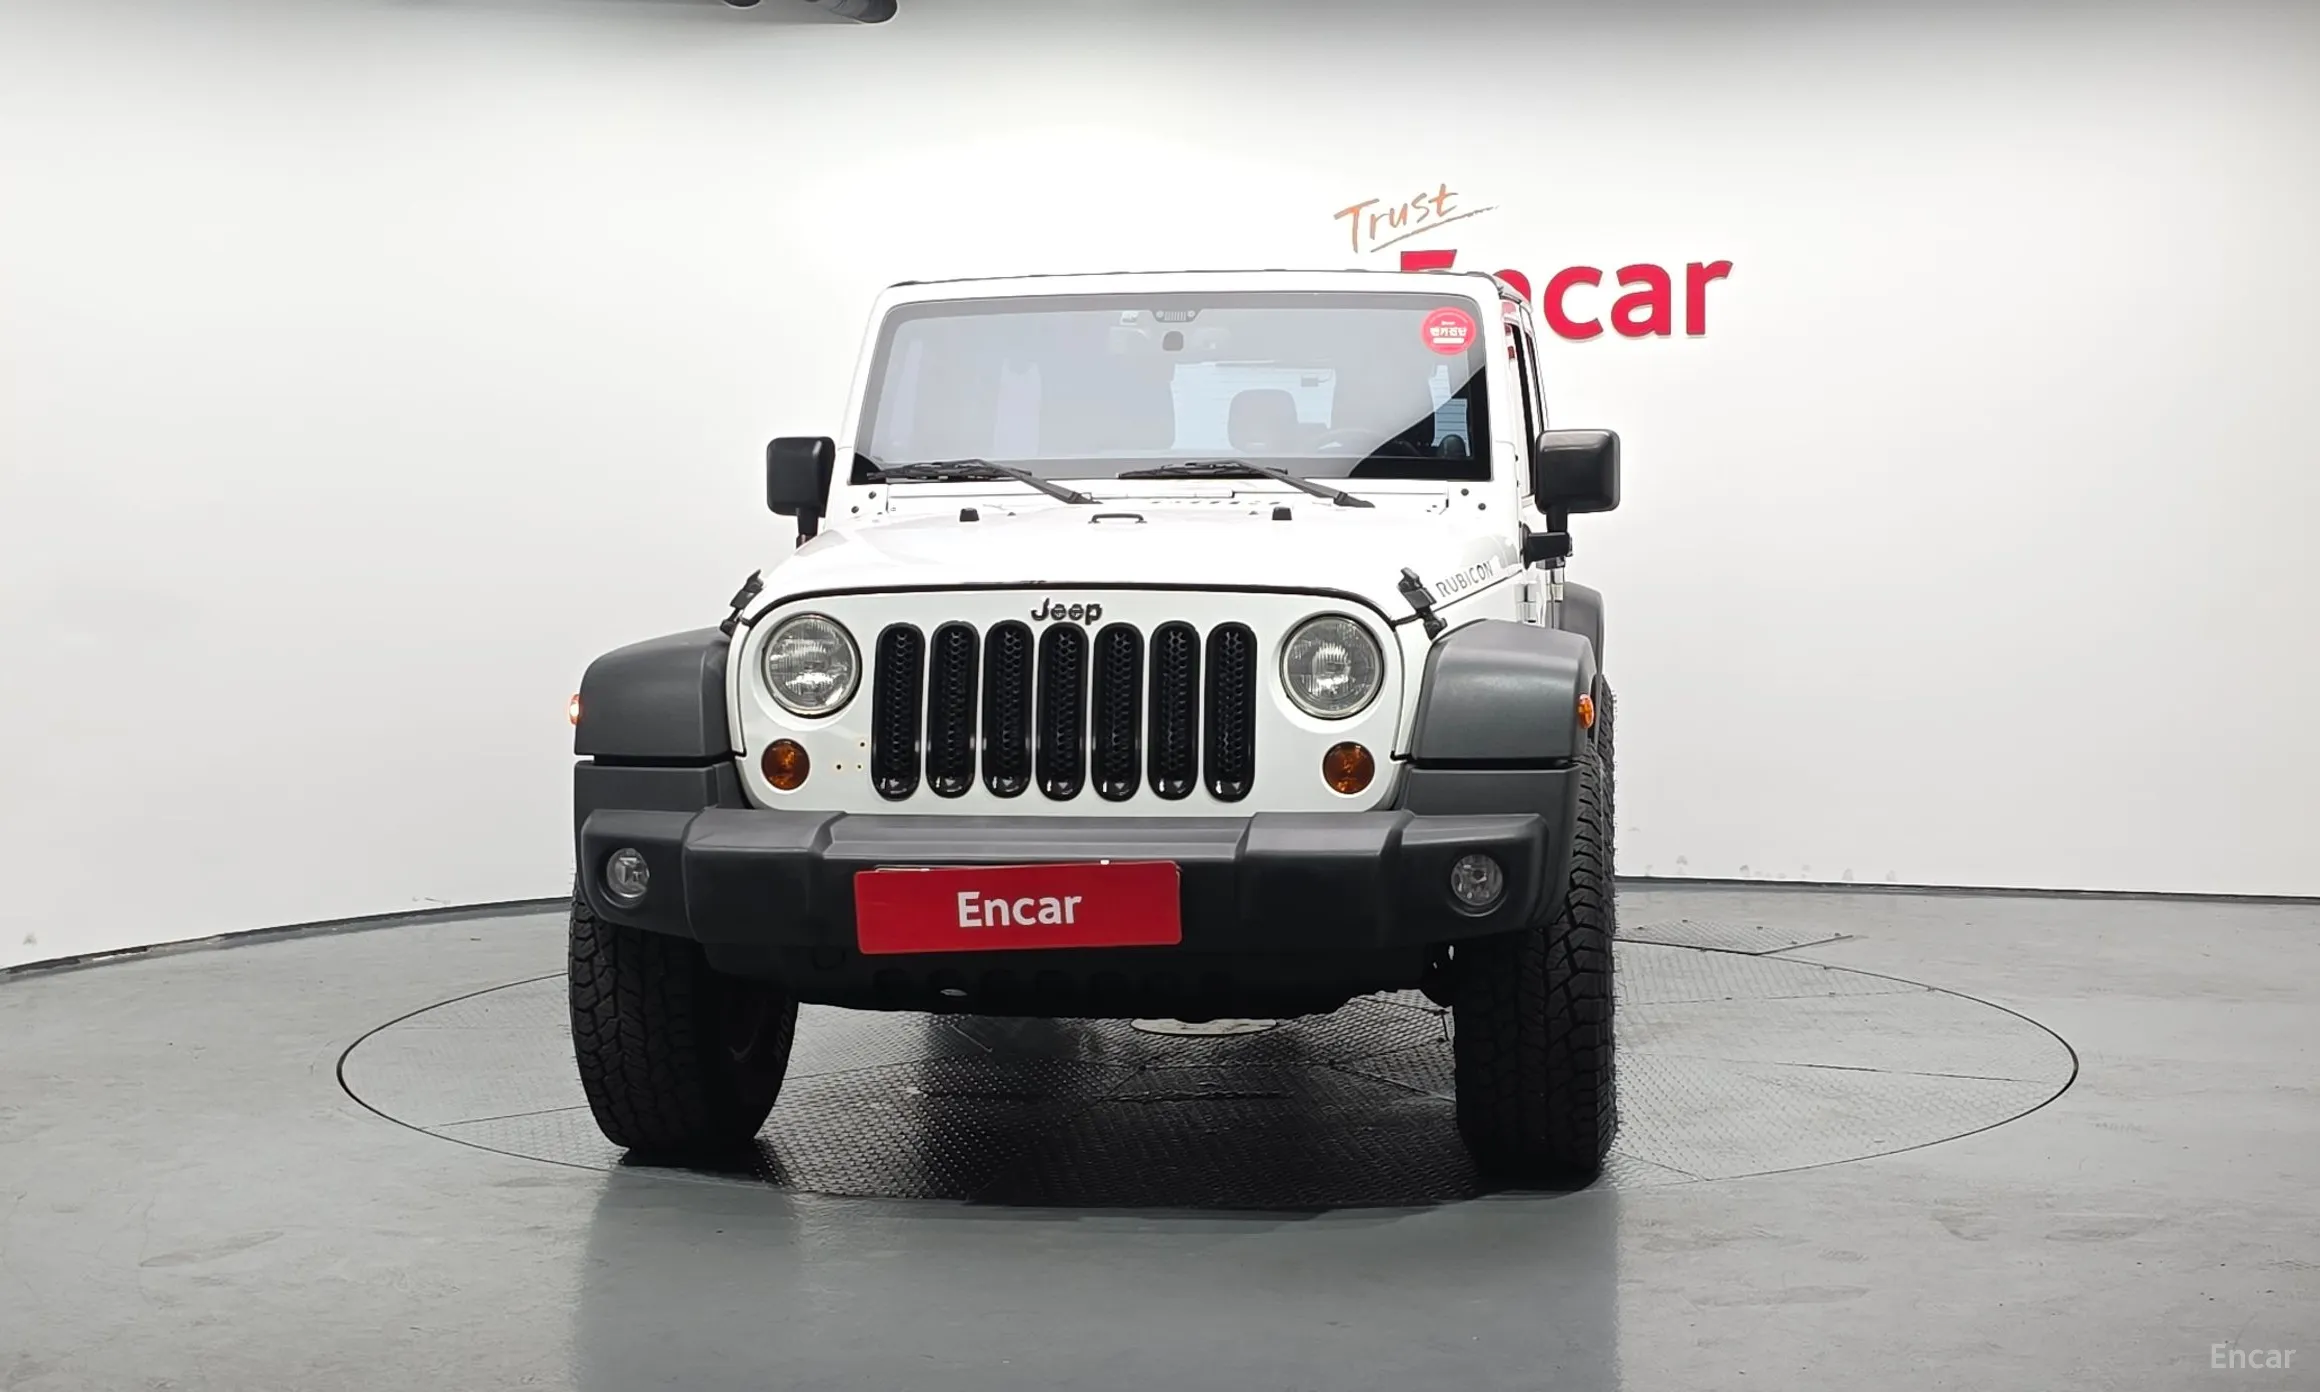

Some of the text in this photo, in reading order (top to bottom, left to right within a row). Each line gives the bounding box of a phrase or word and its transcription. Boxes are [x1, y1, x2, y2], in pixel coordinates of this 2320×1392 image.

[1334, 183, 1458, 253] Trust
[1400, 249, 1734, 341] car
[1435, 560, 1494, 598] RUBICON
[1031, 597, 1103, 626] Jeep
[957, 891, 1082, 928] Encar
